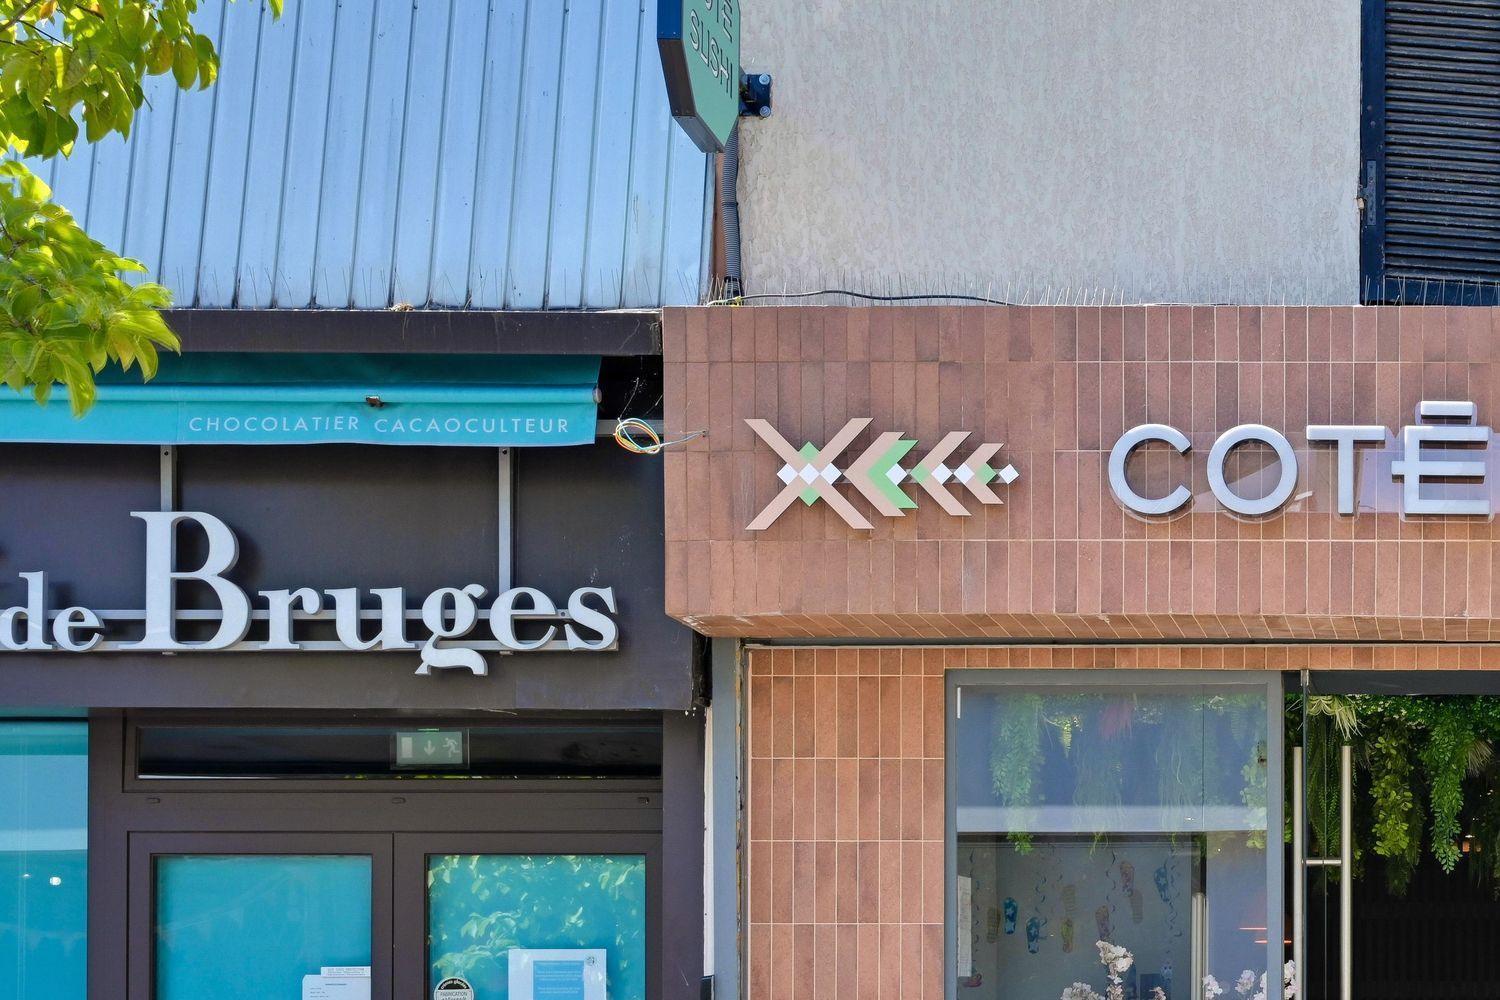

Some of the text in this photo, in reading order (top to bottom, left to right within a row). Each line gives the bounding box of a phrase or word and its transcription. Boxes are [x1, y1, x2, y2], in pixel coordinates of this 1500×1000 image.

[189, 415, 569, 433] CHOCOLATIER CACAOCULTEUR
[0, 511, 619, 676] de Bruges
